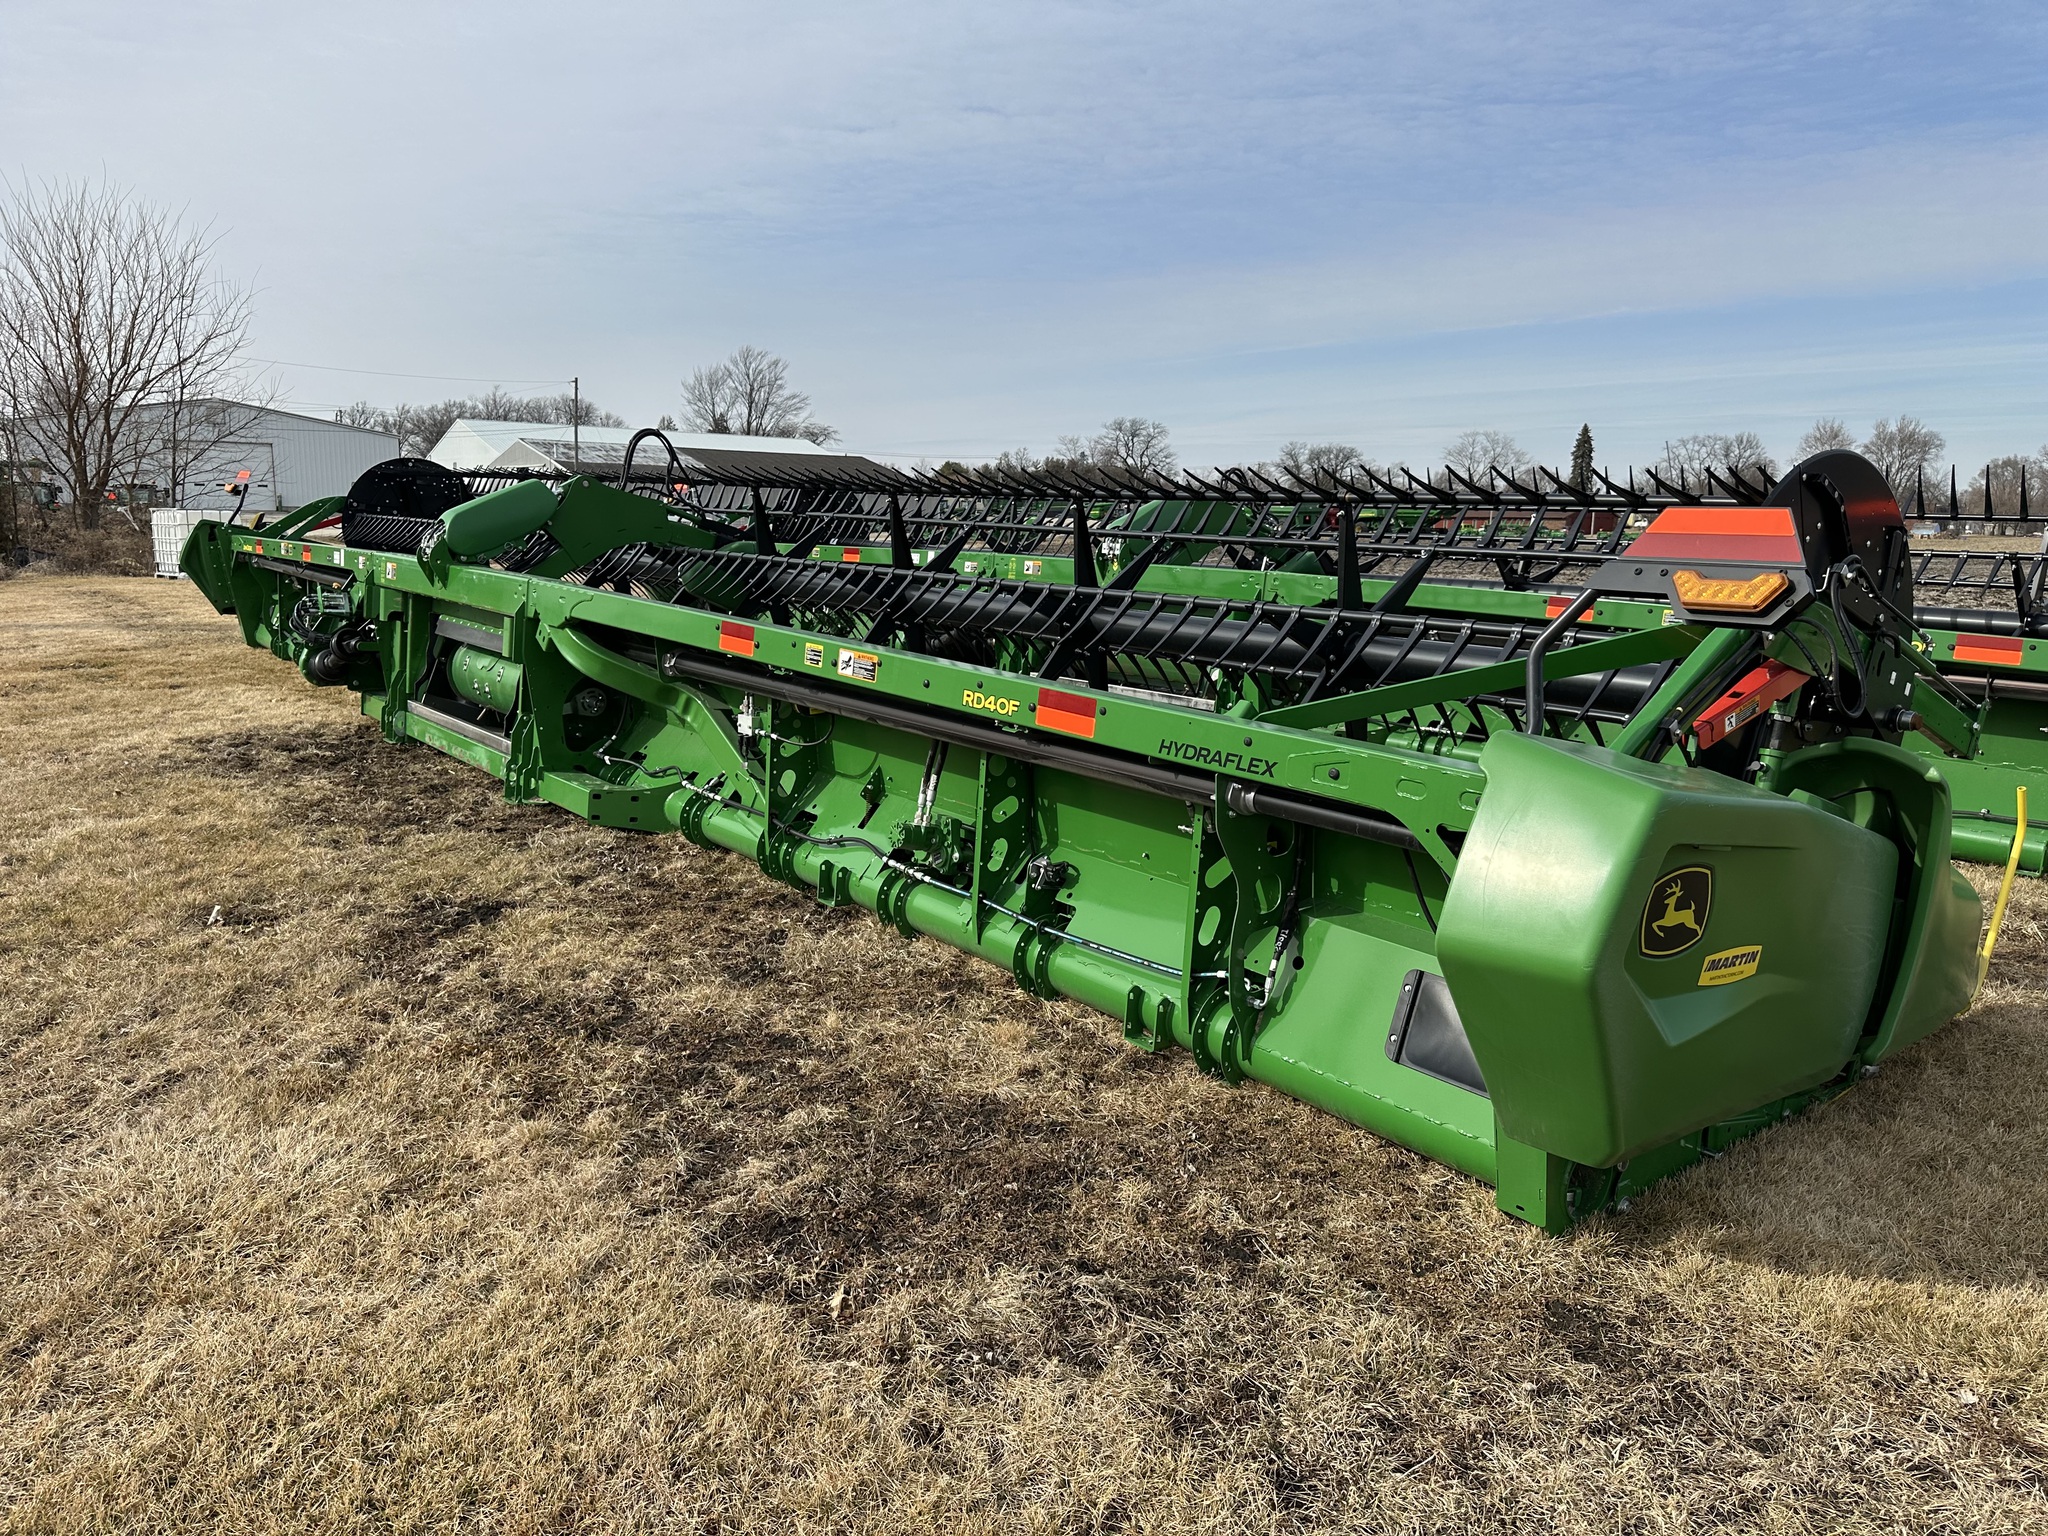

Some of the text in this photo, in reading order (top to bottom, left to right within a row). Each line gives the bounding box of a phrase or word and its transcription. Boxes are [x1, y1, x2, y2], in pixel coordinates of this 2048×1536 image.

[962, 689, 1021, 717] RD40F
[1158, 738, 1279, 779] HYDRAFLEX
[1704, 949, 1760, 973] MARTIN
